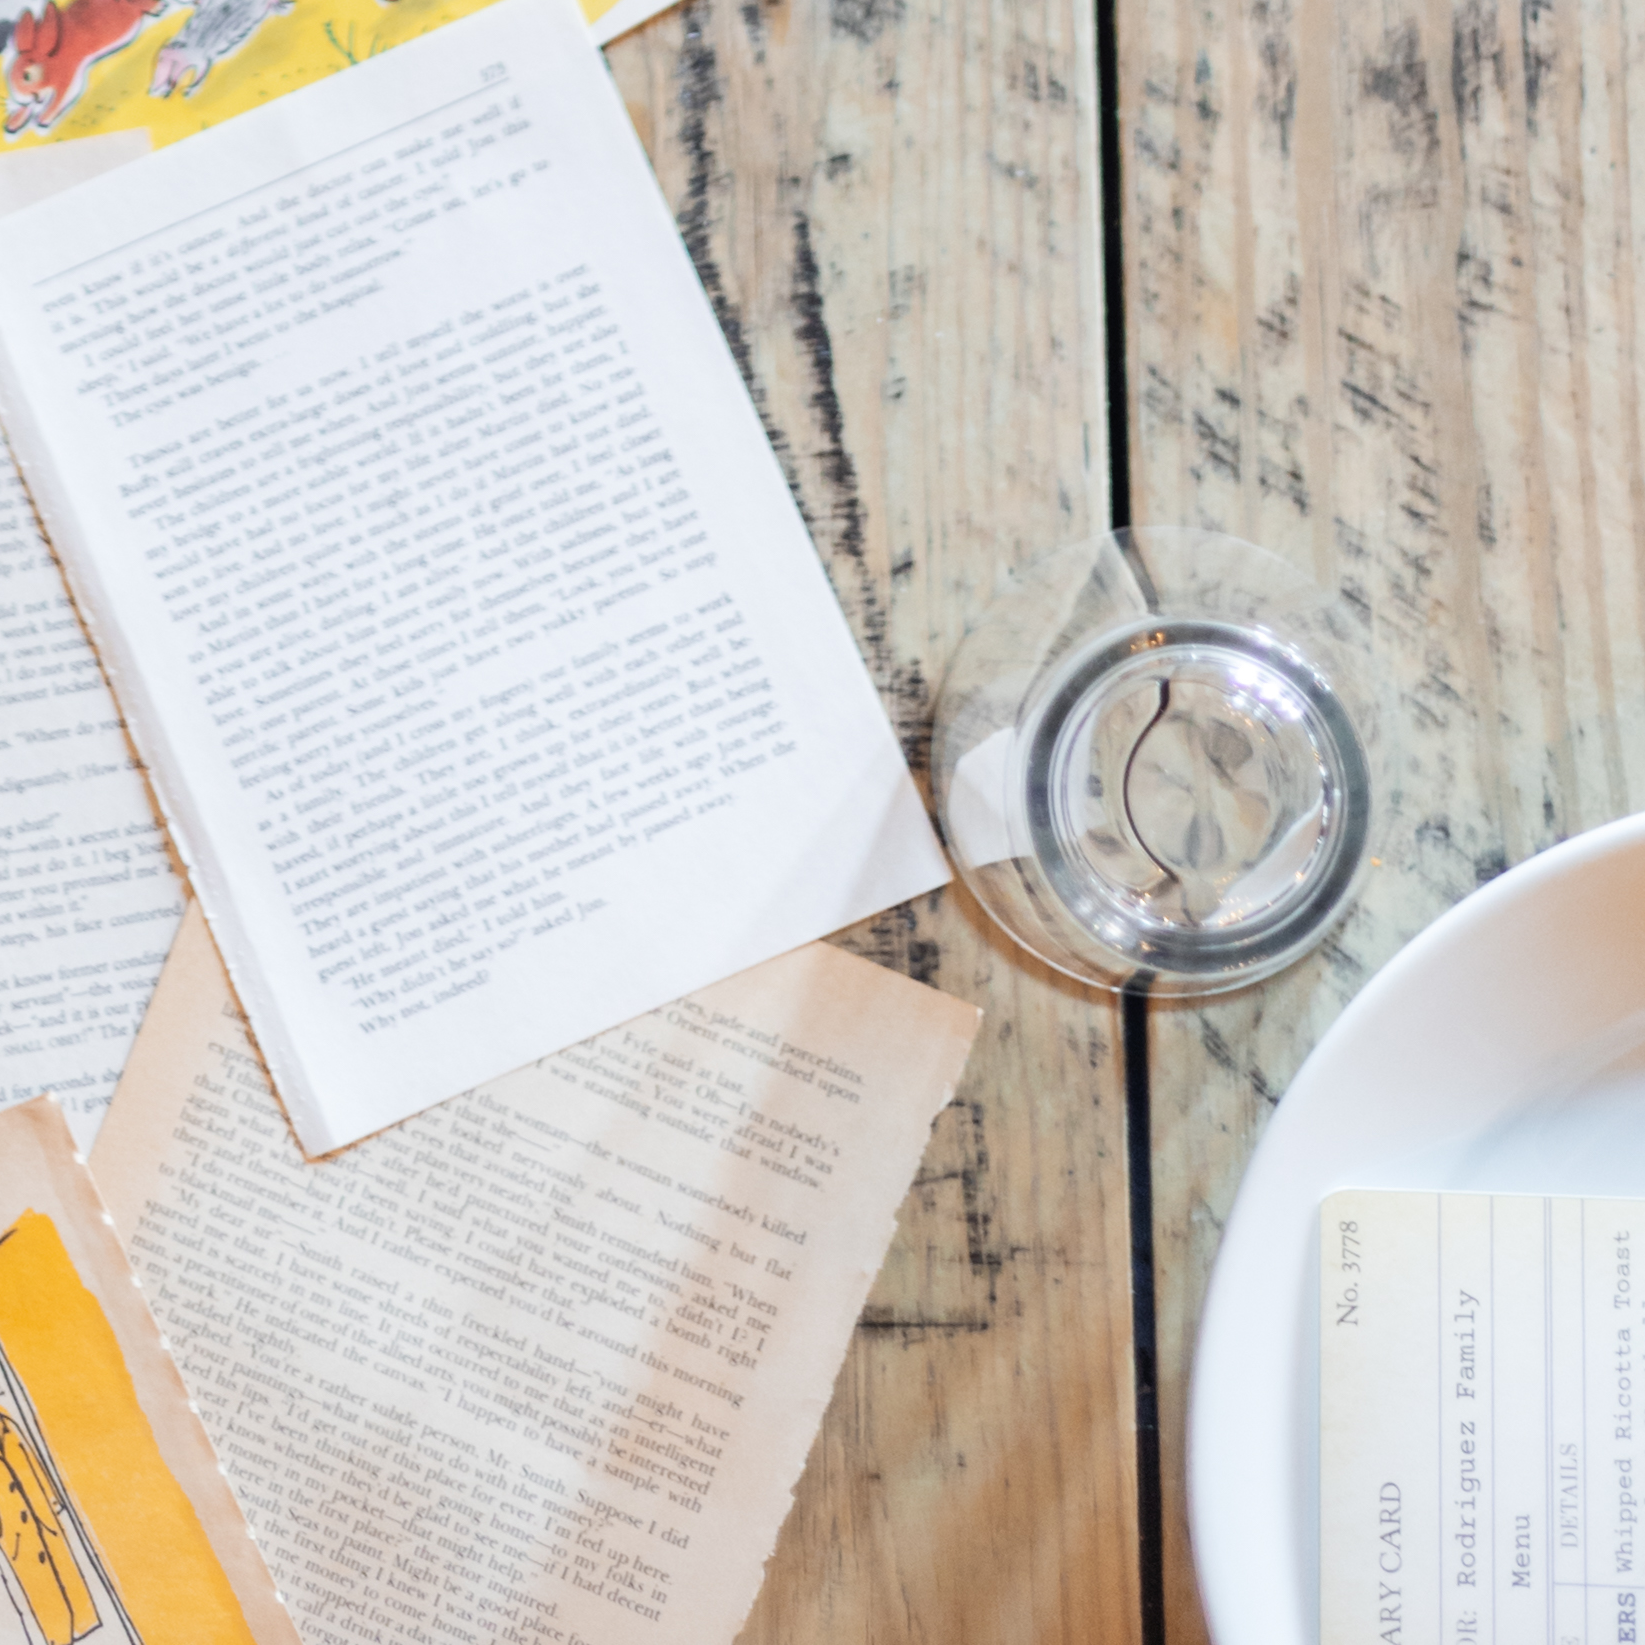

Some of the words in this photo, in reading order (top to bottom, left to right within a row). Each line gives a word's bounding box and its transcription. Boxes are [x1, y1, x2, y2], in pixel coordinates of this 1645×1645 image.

[305, 928, 355, 960] heard
[355, 926, 368, 939] a
[367, 905, 410, 937] guest
[411, 884, 464, 914] saying
[462, 868, 497, 891] that
[497, 857, 524, 875] his
[525, 831, 582, 863] mother
[582, 812, 617, 838] had
[618, 790, 670, 828] passed
[673, 776, 712, 800] away.
[717, 752, 768, 778] When
[770, 739, 797, 757] the
[357, 1012, 397, 1035] Why
[398, 998, 432, 1019] not,
[431, 967, 490, 1005] indeed?
[620, 1029, 658, 1066] Fyfe
[658, 1050, 695, 1073] said
[694, 1066, 713, 1081] at
[712, 1070, 746, 1096] last.
[1337, 1219, 1361, 1273] 3778
[1611, 1229, 1632, 1310] Toast
[1334, 1281, 1359, 1327] No.
[1452, 1287, 1481, 1400] Family
[128, 1226, 169, 1260] man,
[170, 1253, 184, 1265] a
[182, 1257, 279, 1306] practitioner
[278, 1299, 300, 1315] of
[298, 1308, 331, 1328] one
[330, 1322, 351, 1337] of
[350, 1327, 378, 1349] the
[377, 1339, 424, 1369] allied
[422, 1363, 457, 1386] arts,
[461, 1378, 491, 1399] you
[491, 1391, 541, 1422] might
[539, 1413, 605, 1450] possibly
[605, 1437, 629, 1460] be
[626, 1446, 712, 1496] interested
[1611, 1326, 1633, 1441] Ricotta
[1378, 1480, 1402, 1574] CARD
[1453, 1420, 1482, 1588] Rodriguez
[1558, 1442, 1579, 1549] DETAILS
[1612, 1456, 1639, 1574] Whipped
[1510, 1513, 1531, 1589] Menu
